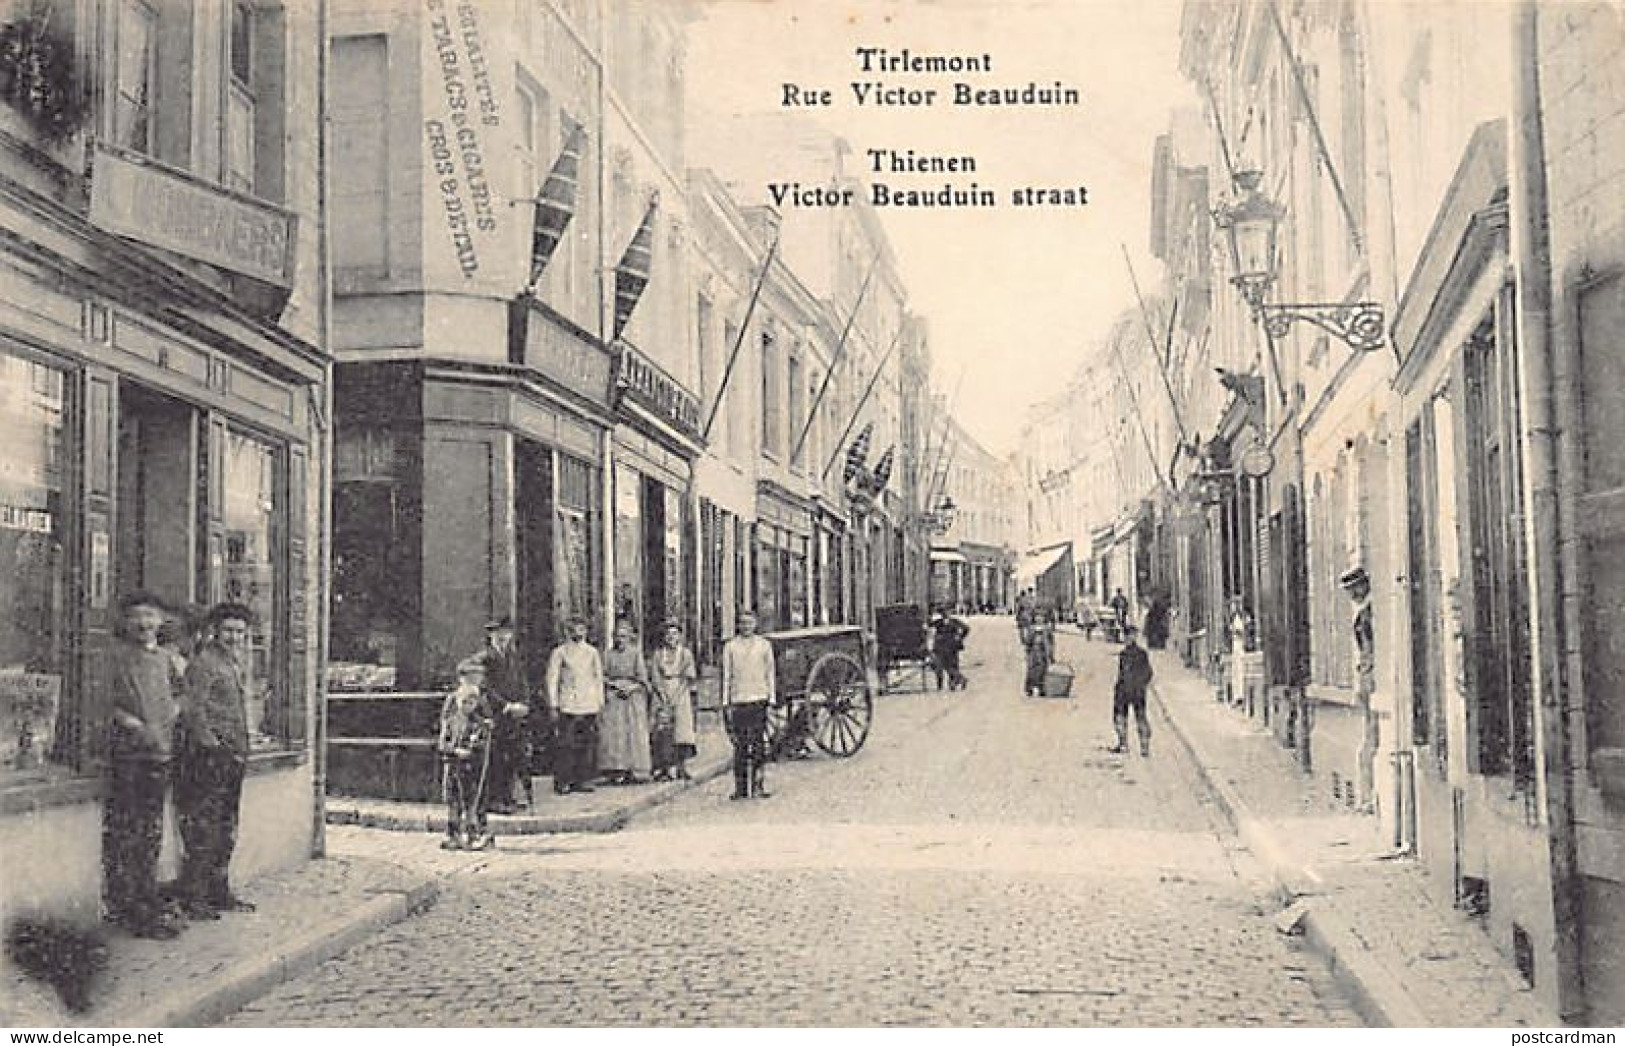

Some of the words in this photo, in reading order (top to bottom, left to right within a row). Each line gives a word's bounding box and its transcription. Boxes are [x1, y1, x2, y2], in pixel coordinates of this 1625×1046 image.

[431, 15, 467, 110] TABACS
[456, 128, 496, 231] CIGARES
[440, 179, 459, 196] &
